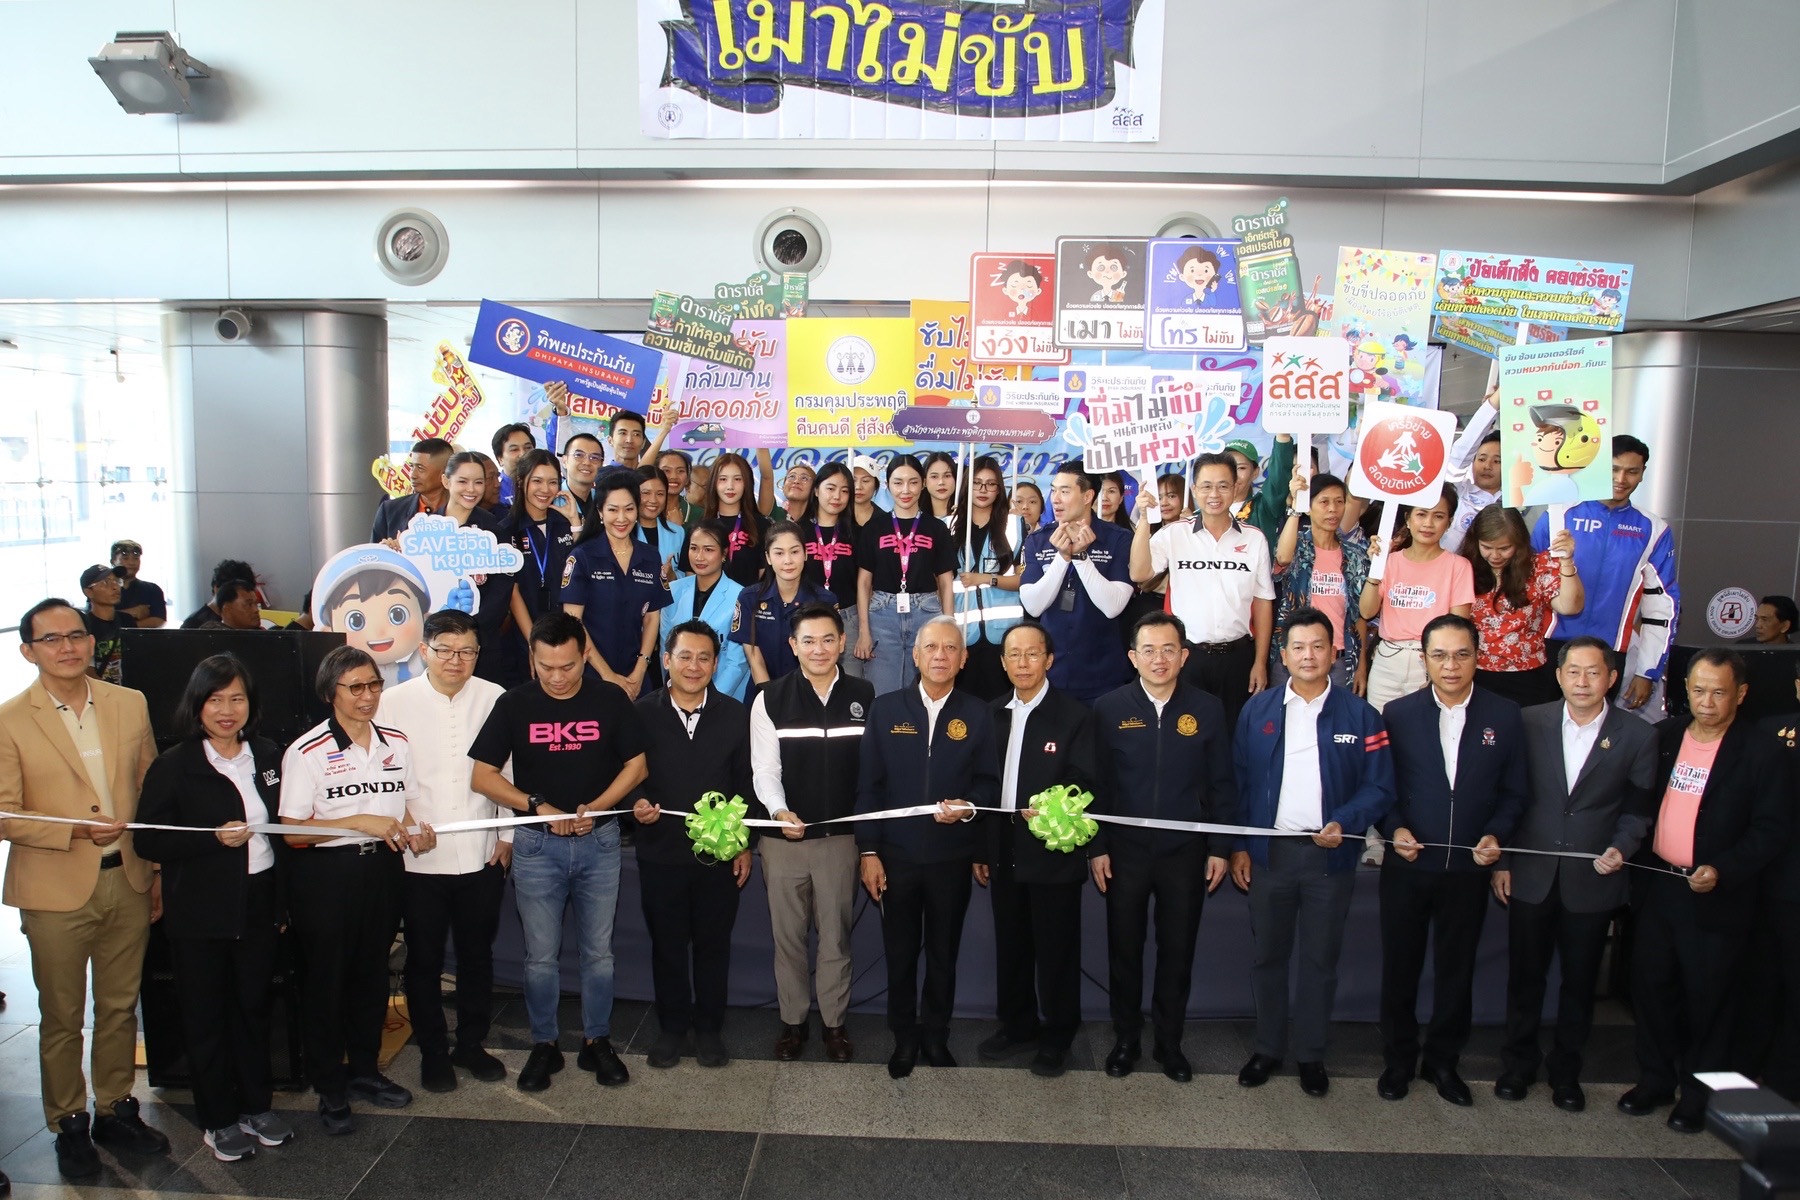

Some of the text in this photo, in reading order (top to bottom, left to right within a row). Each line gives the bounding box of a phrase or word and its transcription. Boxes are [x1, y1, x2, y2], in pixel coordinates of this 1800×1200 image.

[1112, 113, 1144, 127] สสส
[1235, 204, 1285, 233] อาราบัส
[1236, 238, 1283, 255] เอสเปรสโซ
[1250, 264, 1288, 282] อาราบัส
[717, 275, 764, 299] อาราบัส
[1343, 280, 1427, 301] ขับขี่ปลอดภัย
[681, 297, 733, 327] อาราบัส
[674, 319, 731, 346] ท้าให้ลอง
[1067, 319, 1112, 340] เมา
[1160, 317, 1235, 345] โทร ไม่ขับ
[536, 330, 637, 375] ทิพยประกันภัย
[644, 332, 754, 369] ความเข้มเต็มพิกัด
[981, 329, 1029, 357] ง่วง
[534, 351, 632, 386] DHIPAYA INSURANCE
[1504, 353, 1517, 362] ขับ
[1268, 370, 1344, 400] สสส
[678, 391, 779, 420] ปลอดภัย
[795, 391, 907, 415] กรมคุมประพฤติ
[1087, 382, 1203, 427] ดื่มไม่ขับ
[1269, 401, 1341, 411] สำนักงานกองทุนสนับสนุน
[1269, 410, 1341, 419] การสร้างเสริมสุขภาพ
[796, 416, 894, 442] คืนคนดี สู่สังค
[1113, 416, 1173, 438] คนข้างหลัง
[1085, 428, 1197, 470] เป็นห่วง
[1368, 464, 1426, 490] ลดอุบัติเหตุ
[414, 517, 454, 534] พี่ครับๆ
[1572, 517, 1603, 533] TIP
[1617, 523, 1643, 533] SMART
[433, 547, 518, 573] หยุดขับเร็ว
[1177, 559, 1251, 573] HONDA
[529, 720, 600, 744] BKS
[1333, 733, 1359, 744] SRT
[262, 769, 276, 782] DOP
[326, 780, 406, 800] HONDA
